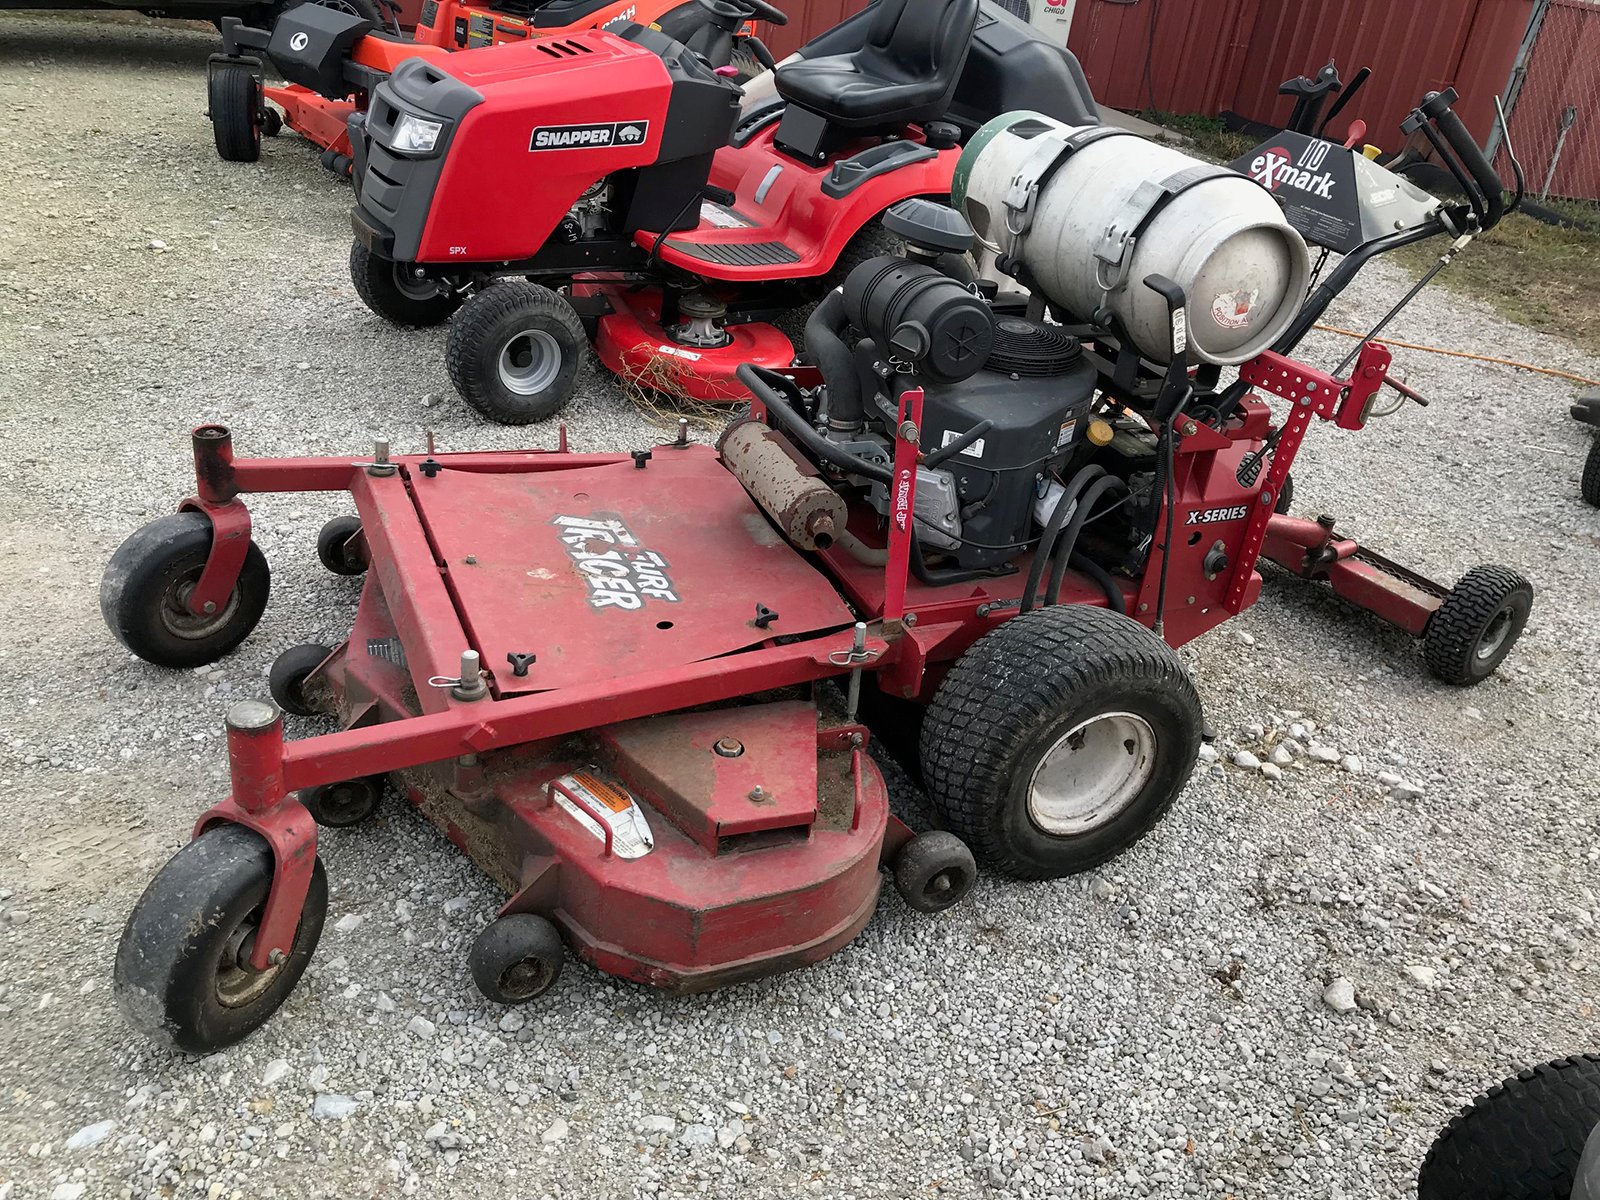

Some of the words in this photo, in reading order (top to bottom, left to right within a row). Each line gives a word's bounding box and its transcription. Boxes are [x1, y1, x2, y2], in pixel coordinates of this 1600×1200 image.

[1043, 6, 1066, 15] CHIGO
[535, 129, 611, 147] SNAPPER
[449, 246, 467, 255] SPX
[1215, 307, 1240, 326] POSITION
[1185, 506, 1248, 525] X-SERIES
